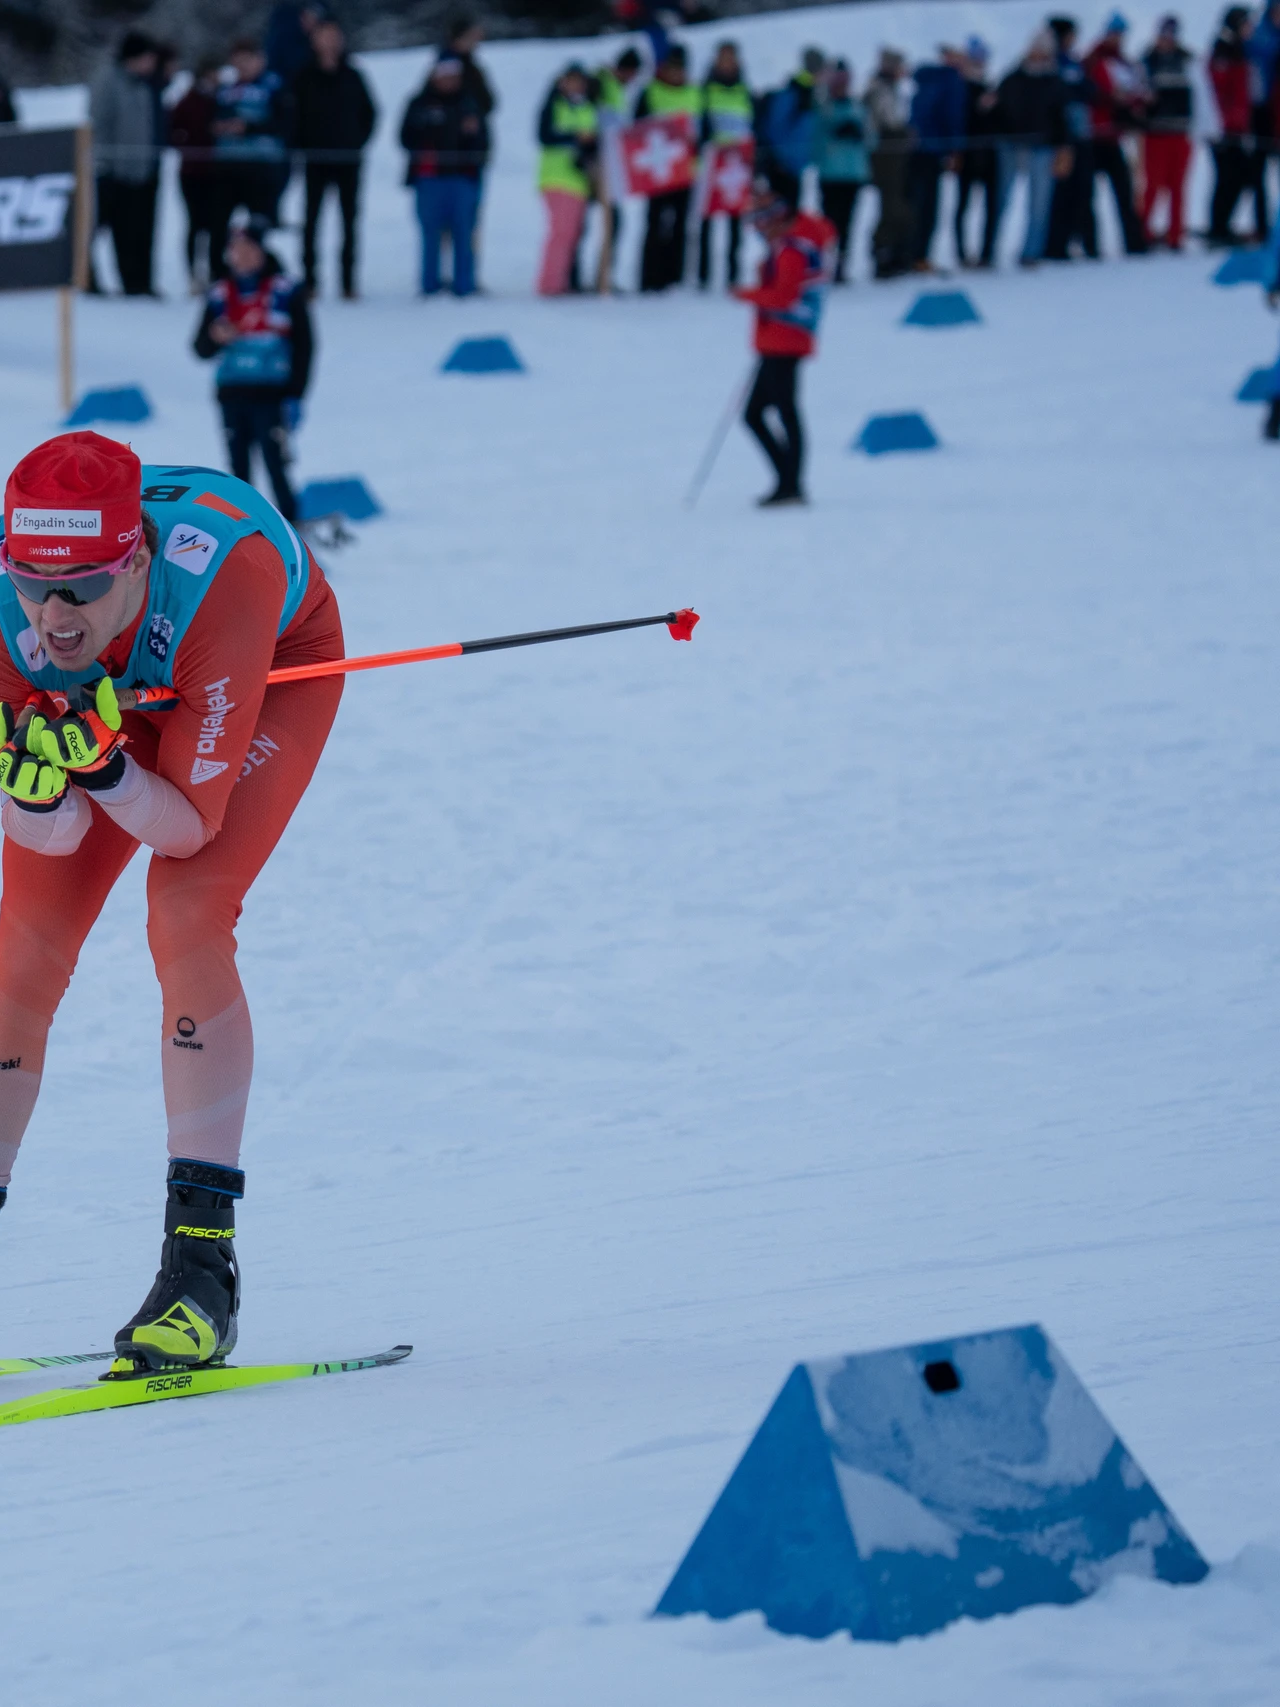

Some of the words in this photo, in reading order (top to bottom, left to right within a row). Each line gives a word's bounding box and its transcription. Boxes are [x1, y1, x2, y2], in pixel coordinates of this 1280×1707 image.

[23, 516, 65, 530] Engadin
[68, 518, 97, 529] Scuol
[28, 545, 71, 556] swissski
[196, 676, 235, 754] helvetia
[172, 1037, 204, 1050] Sunrise
[146, 1375, 193, 1394] FISCHER
